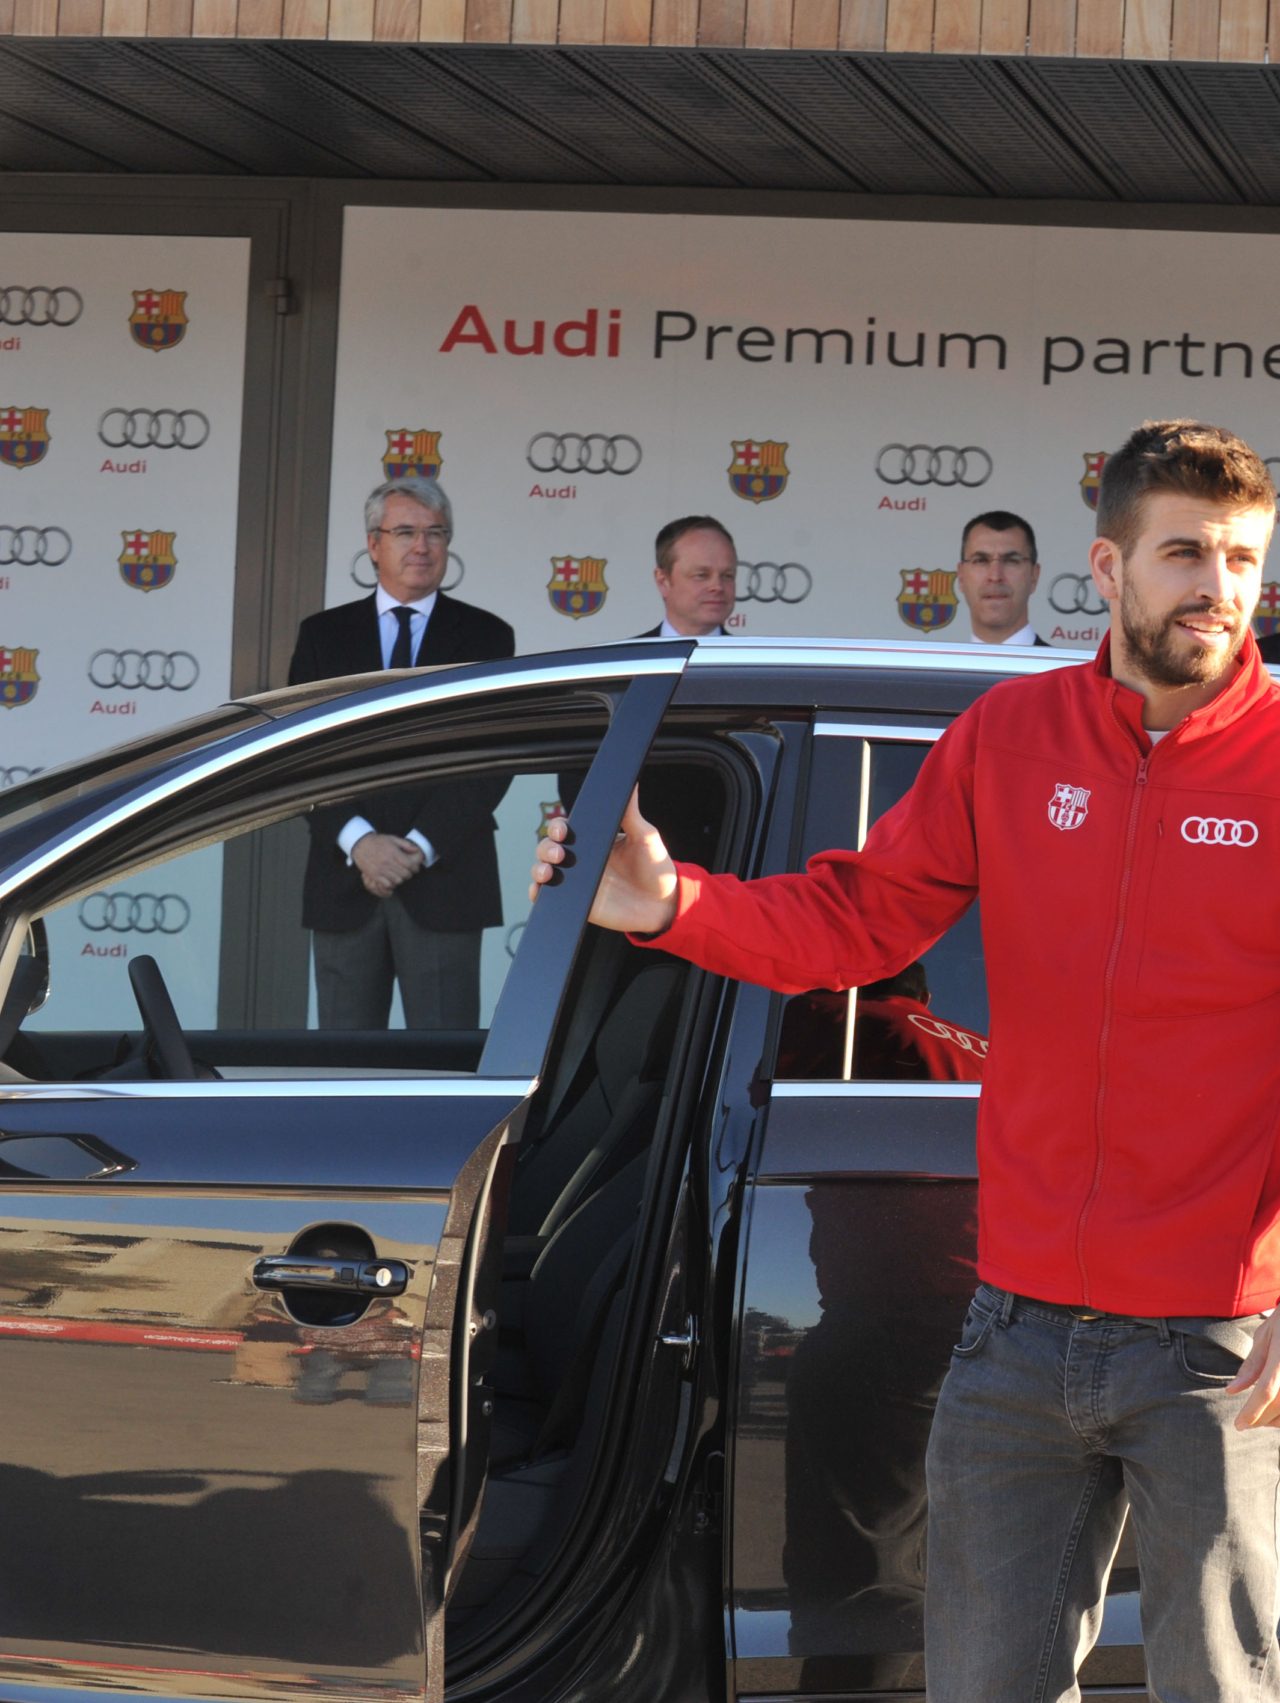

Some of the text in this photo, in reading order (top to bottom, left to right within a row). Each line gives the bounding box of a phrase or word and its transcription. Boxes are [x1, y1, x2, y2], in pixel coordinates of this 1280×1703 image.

[0, 337, 21, 350] di
[439, 305, 621, 357] Audi
[654, 311, 1006, 371] Premium
[99, 459, 147, 473] Audi
[528, 484, 577, 498] Audi
[879, 496, 927, 510] Audi
[727, 614, 746, 628] di
[1051, 627, 1099, 641] Audi
[90, 700, 136, 715] Audi
[81, 943, 128, 958] Audi
